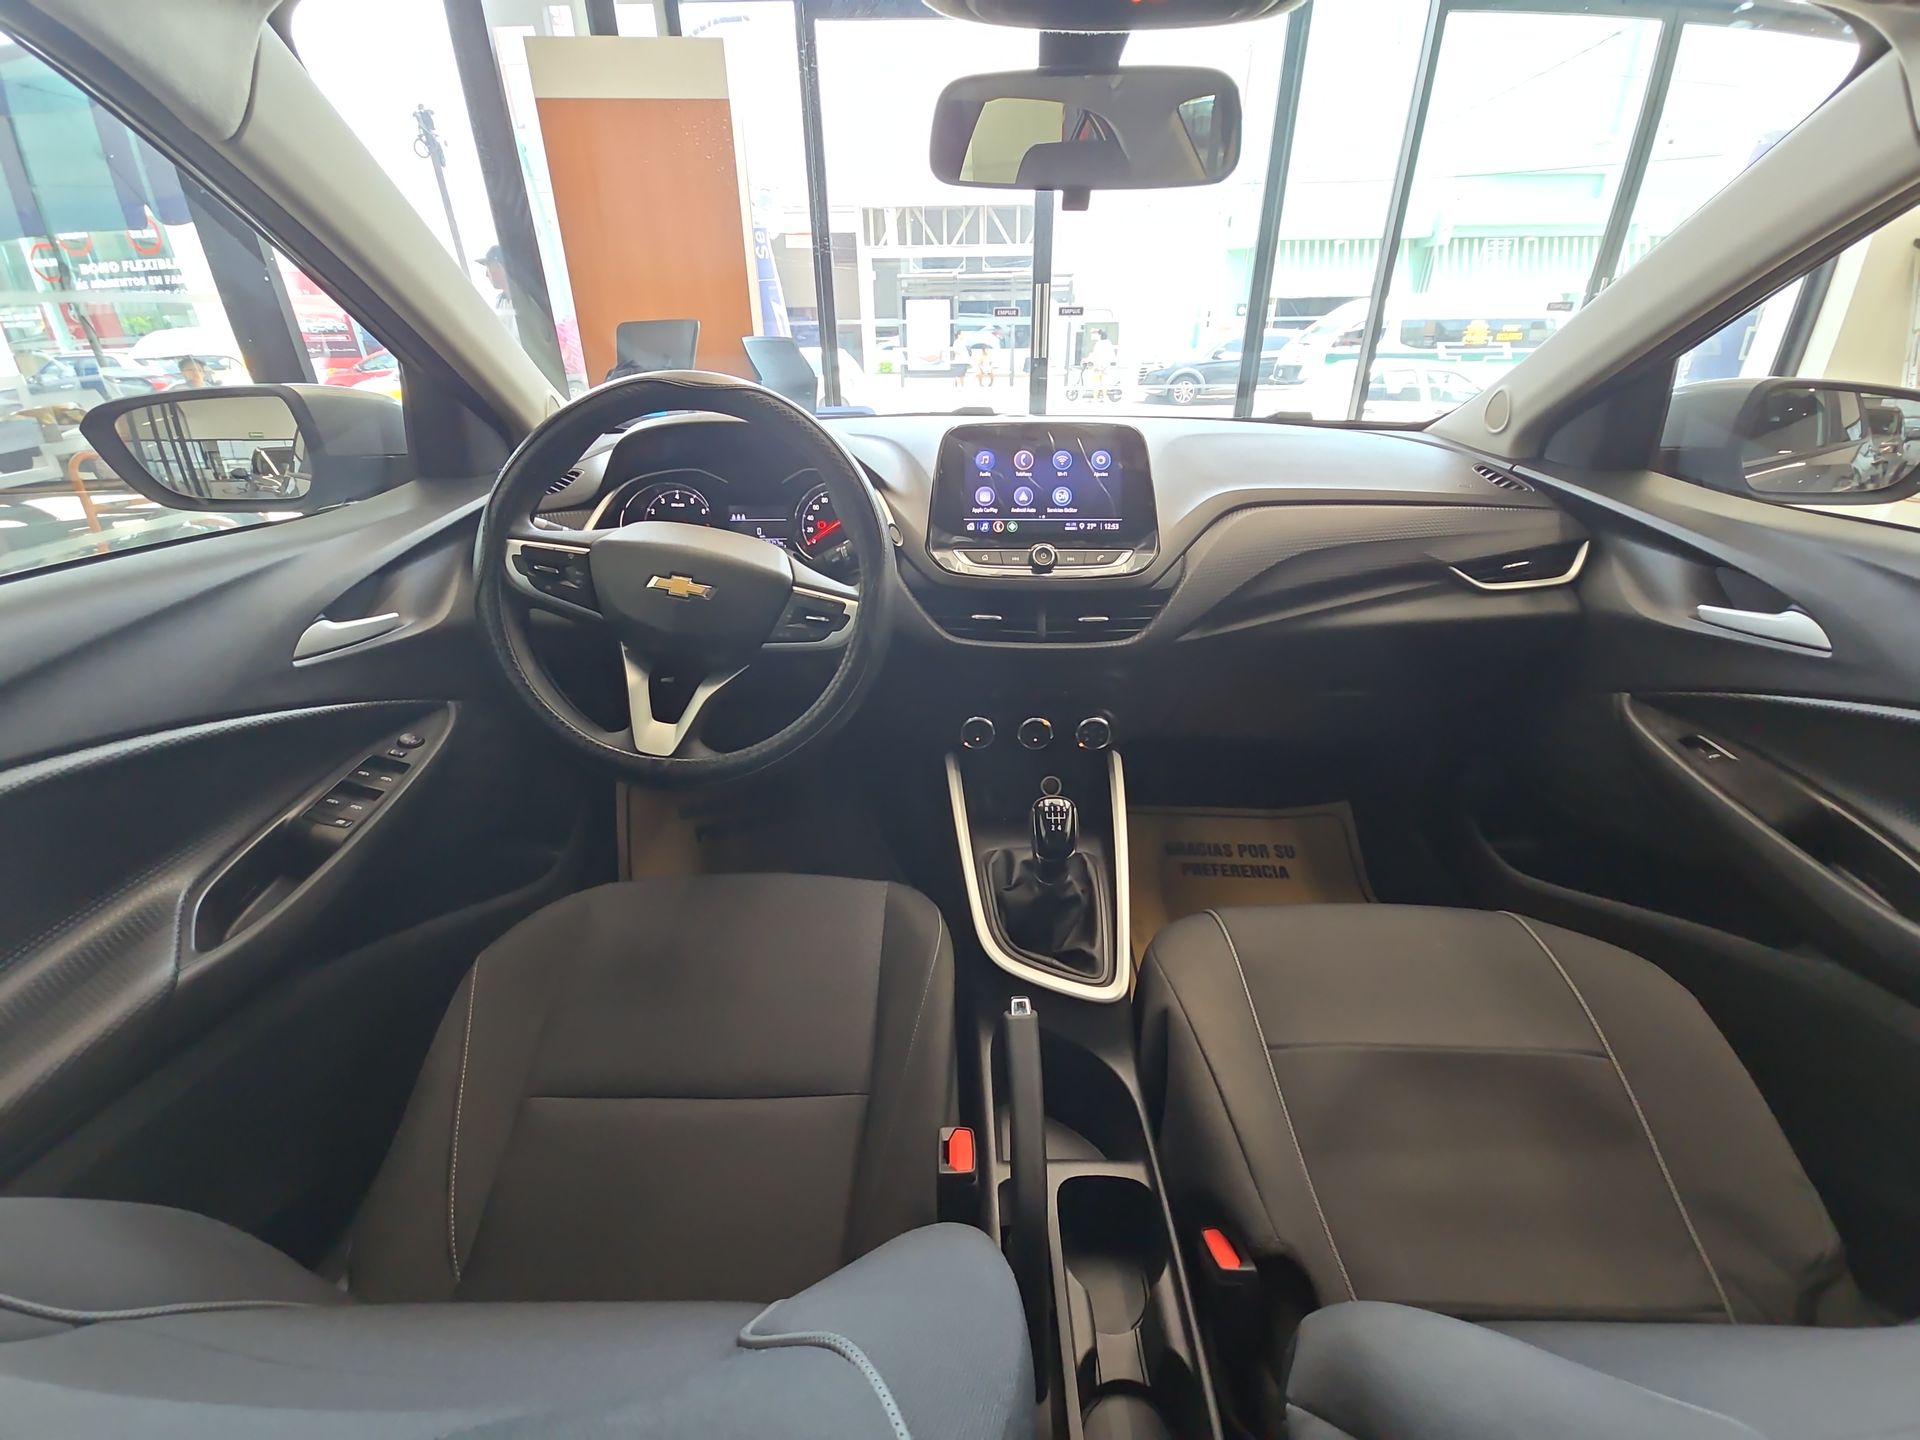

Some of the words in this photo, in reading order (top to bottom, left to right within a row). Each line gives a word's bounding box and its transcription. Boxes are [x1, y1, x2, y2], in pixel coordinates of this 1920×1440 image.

[79, 261, 120, 275] BONO
[1237, 843, 1270, 859] POR
[1273, 844, 1296, 859] SU
[1181, 863, 1290, 879] PREFERENCIA
